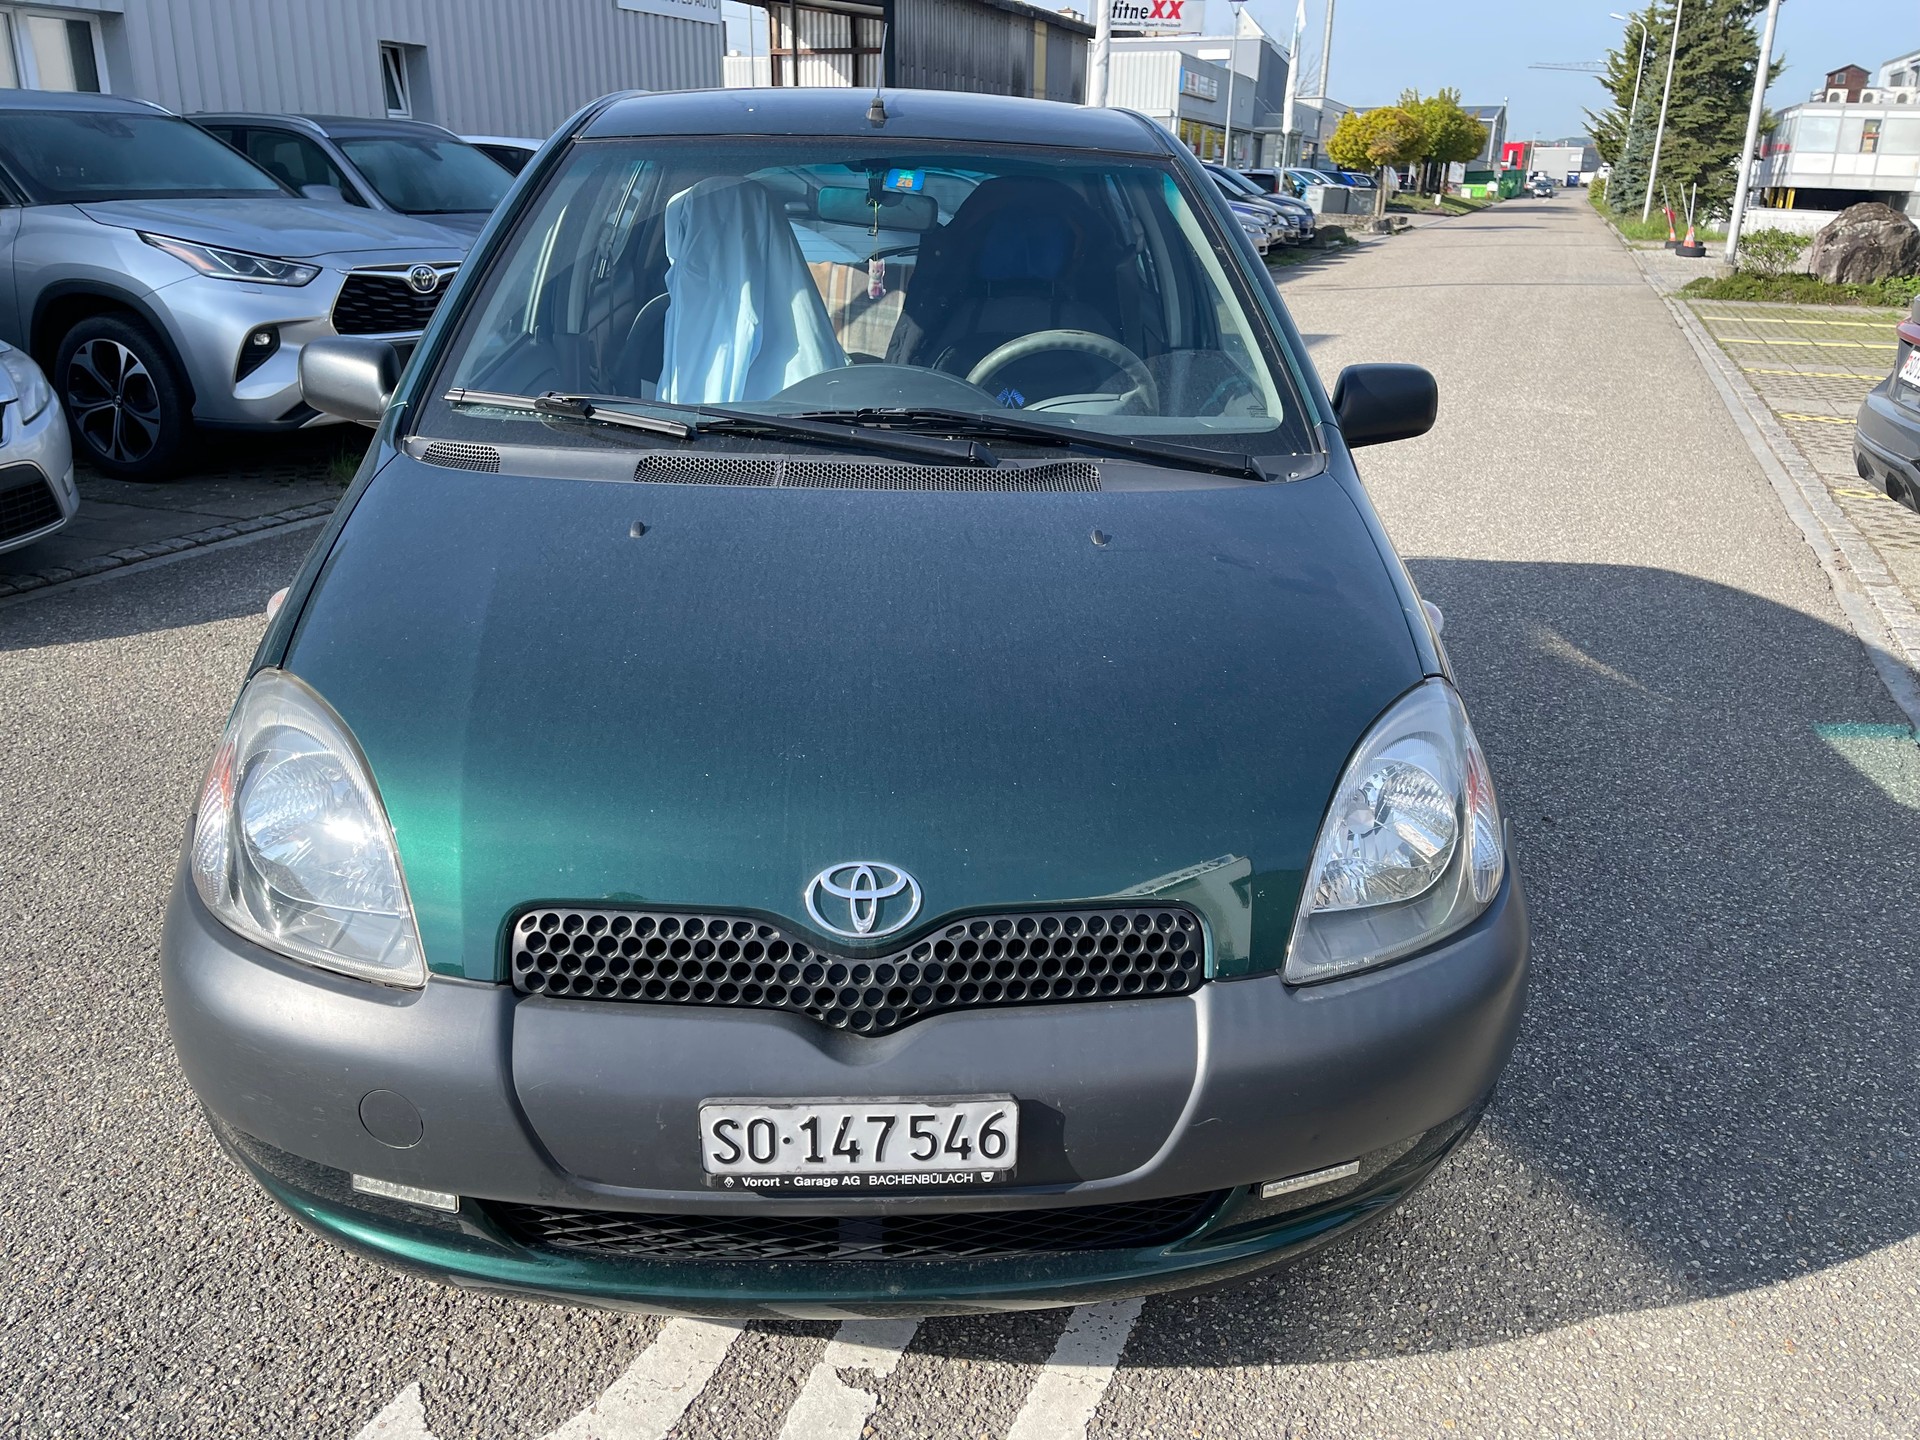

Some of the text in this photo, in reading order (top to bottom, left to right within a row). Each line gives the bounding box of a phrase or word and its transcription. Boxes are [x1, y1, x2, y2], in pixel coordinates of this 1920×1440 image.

[742, 1177, 781, 1187] Vorort
[794, 1176, 839, 1187] Garage
[841, 1175, 861, 1186] AG
[869, 1173, 974, 1186] BACHENBÜLACH
